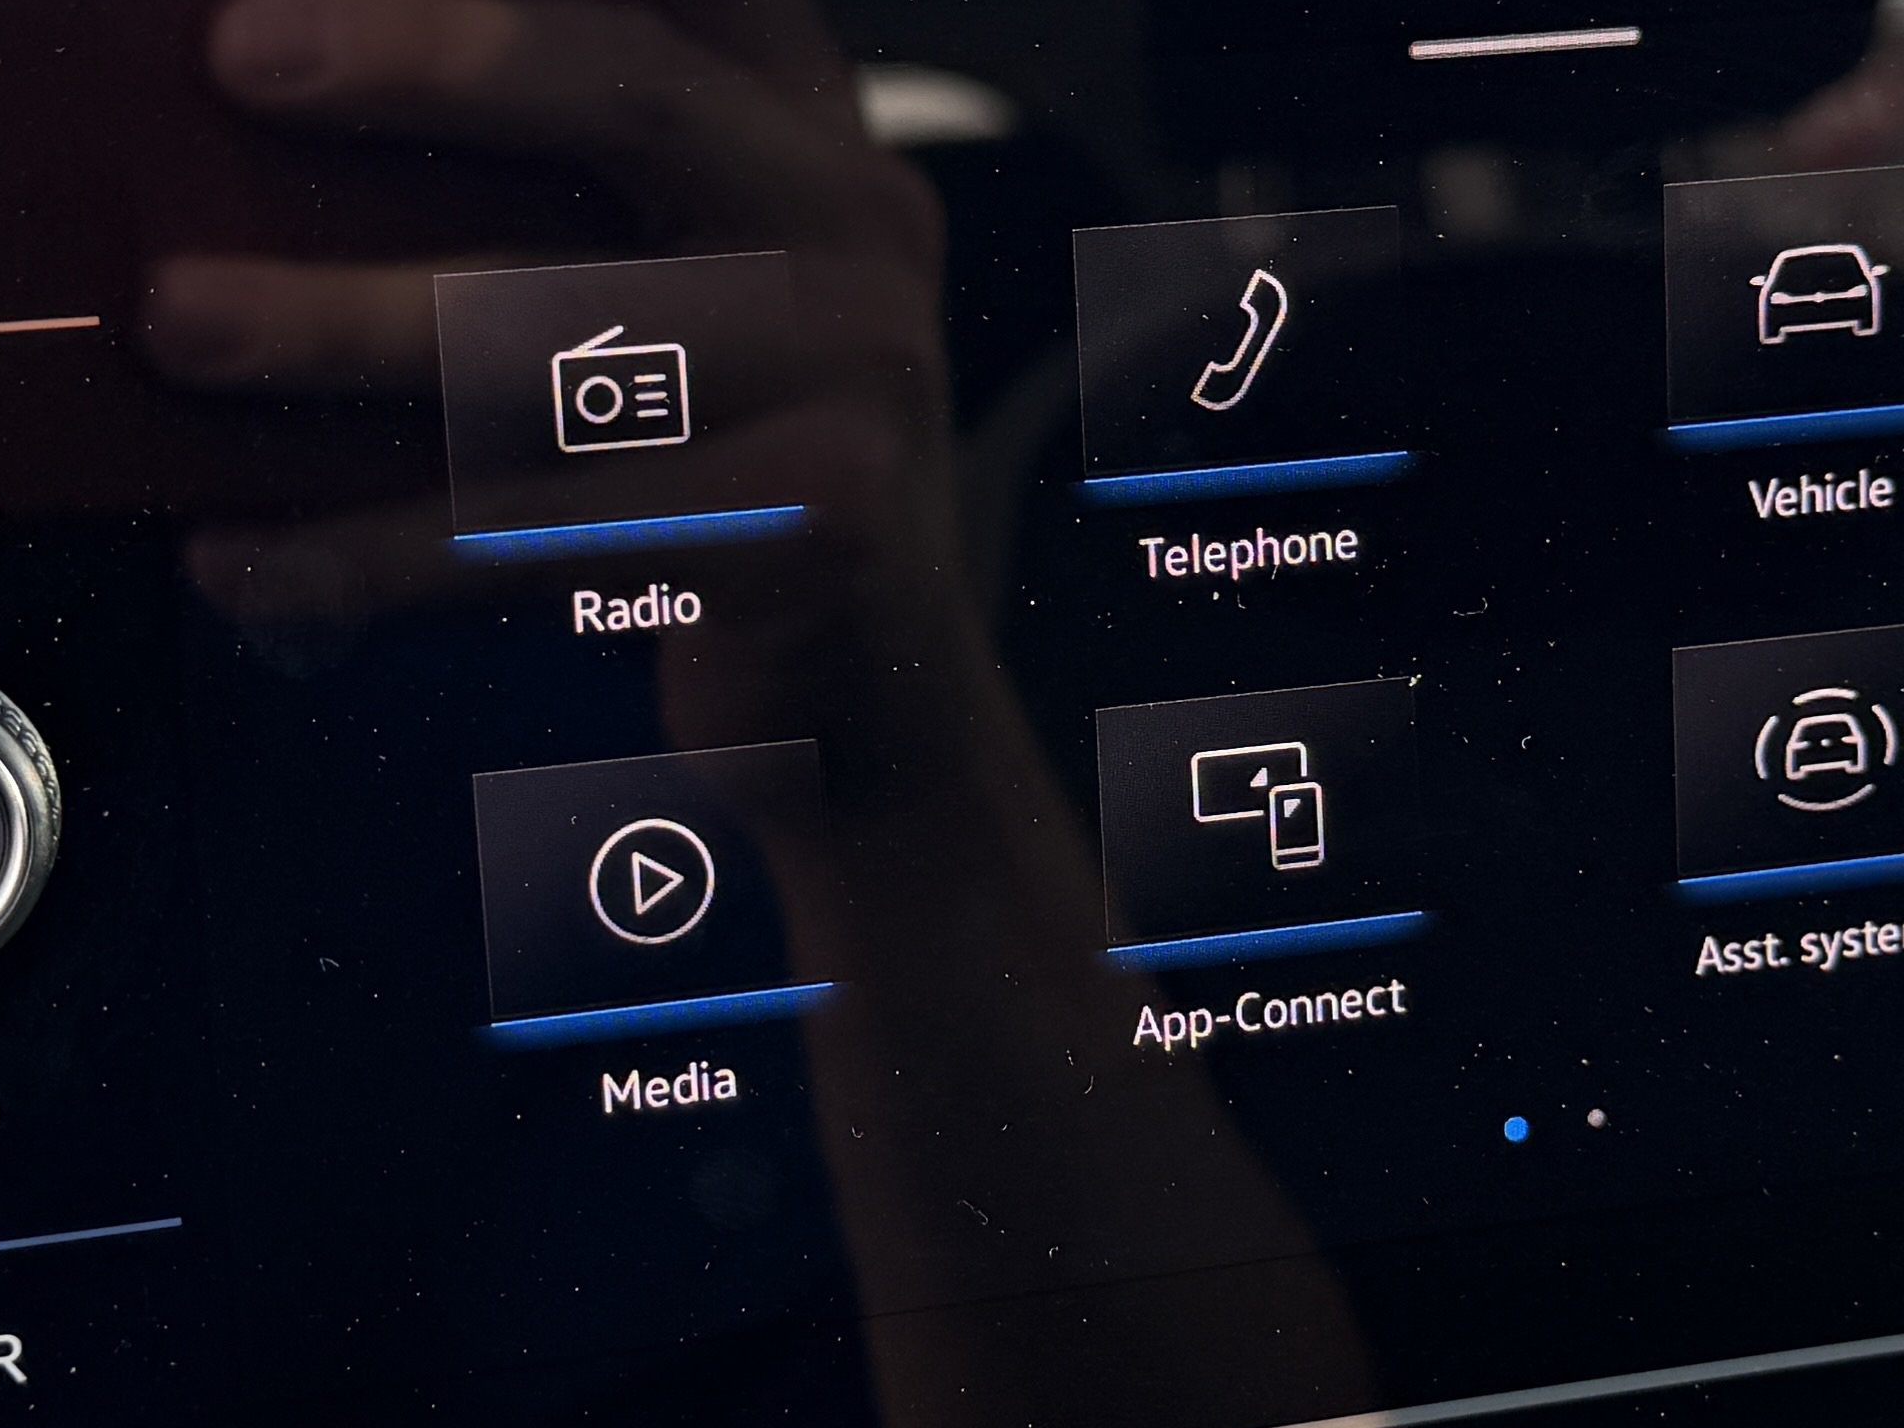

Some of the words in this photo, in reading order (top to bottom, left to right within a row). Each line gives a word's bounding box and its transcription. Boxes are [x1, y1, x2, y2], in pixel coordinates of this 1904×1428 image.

[1747, 467, 1897, 522] Vehicle
[1137, 522, 1364, 586] Telephone
[571, 581, 704, 636] Radio
[1693, 930, 1791, 978] Asst.
[1130, 975, 1409, 1054] App-Connect
[599, 1058, 741, 1117] Media
